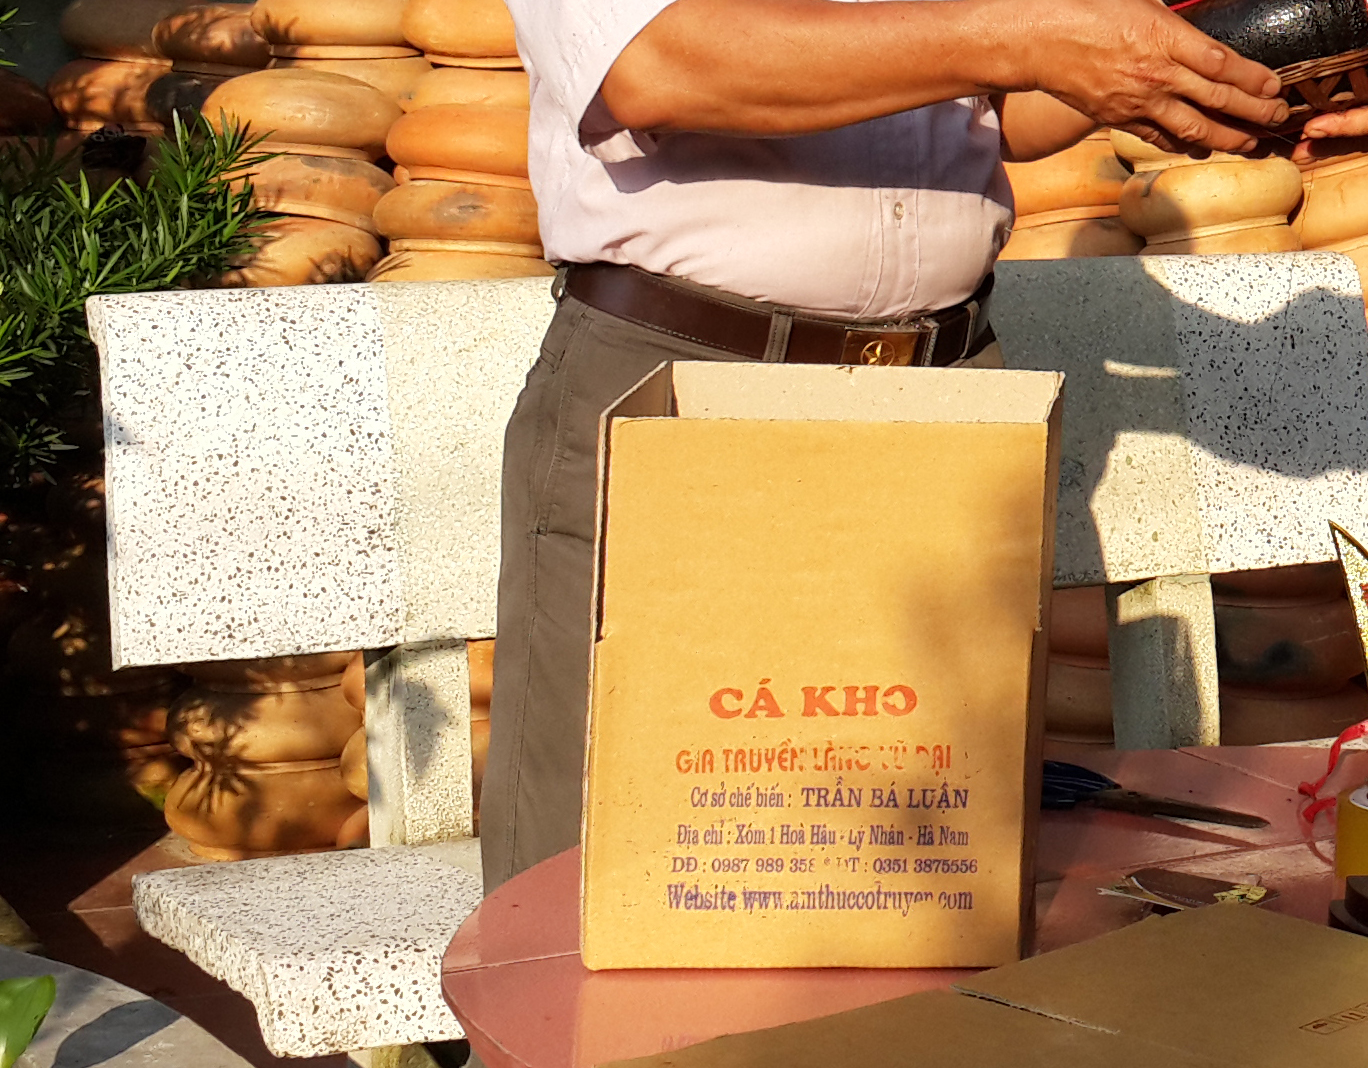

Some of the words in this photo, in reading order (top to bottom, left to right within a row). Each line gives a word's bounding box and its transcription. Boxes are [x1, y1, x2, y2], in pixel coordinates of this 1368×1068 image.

[709, 678, 786, 719] CÁ
[800, 684, 918, 717] KHO
[676, 748, 715, 774] GIA
[690, 786, 709, 808] Cơ
[711, 781, 727, 808] sở
[729, 782, 755, 808] chế
[801, 776, 863, 808] TRẦN
[869, 781, 900, 809] BÁ
[906, 779, 970, 814] LUẬN
[676, 824, 699, 849] Địa
[734, 823, 766, 845] Xóm
[770, 826, 776, 845] 1
[916, 824, 935, 846] Hà
[938, 825, 969, 846] Nam
[711, 857, 750, 873] 0987
[755, 857, 785, 873] 989
[913, 858, 978, 874] 3875556
[667, 883, 737, 910] Website
